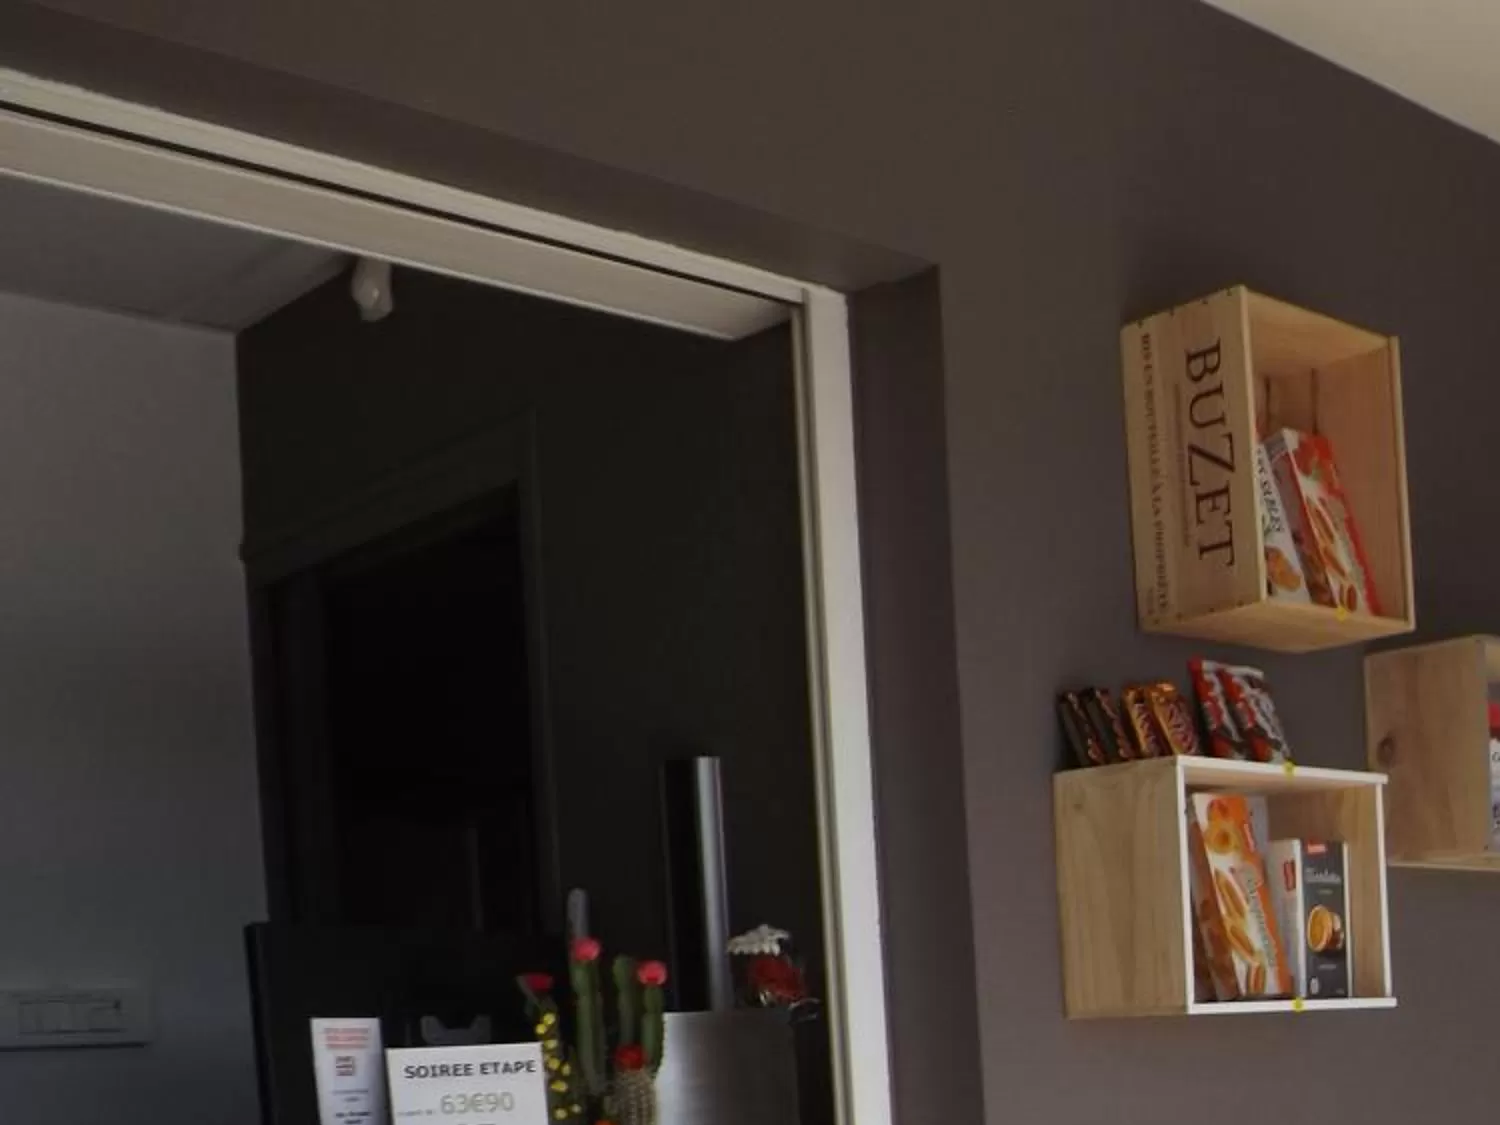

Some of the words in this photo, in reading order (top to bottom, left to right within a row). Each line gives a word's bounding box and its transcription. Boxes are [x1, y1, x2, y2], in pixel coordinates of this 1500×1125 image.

[1184, 337, 1236, 567] BUZET
[404, 1063, 474, 1079] SOIREE
[480, 1060, 537, 1075] ETAPE
[441, 1091, 515, 1115] 63€90
